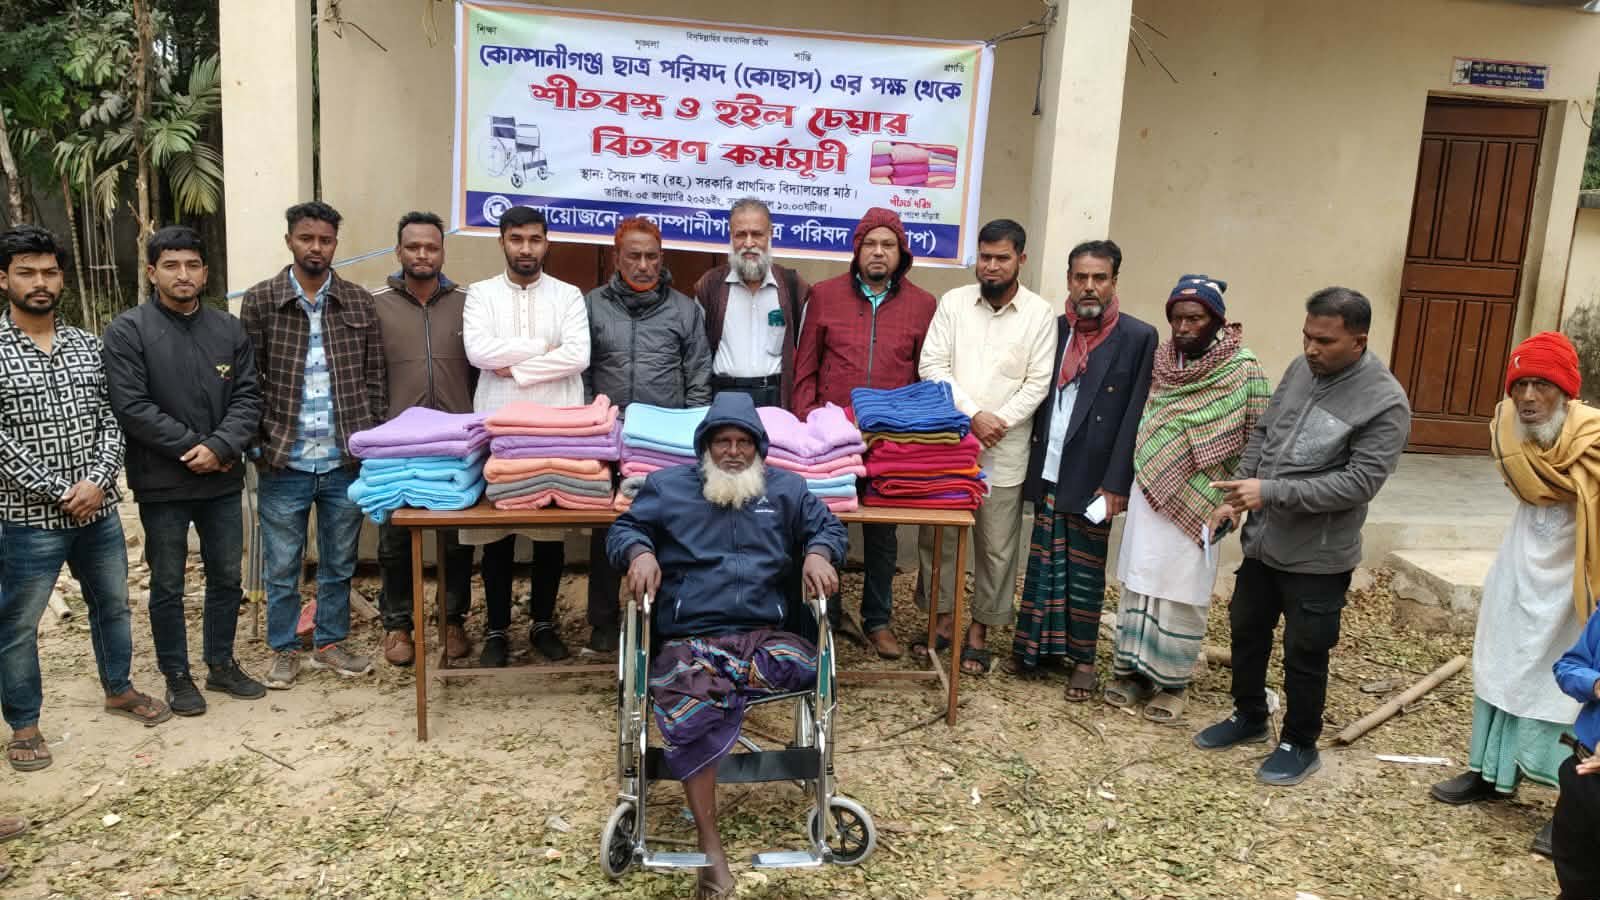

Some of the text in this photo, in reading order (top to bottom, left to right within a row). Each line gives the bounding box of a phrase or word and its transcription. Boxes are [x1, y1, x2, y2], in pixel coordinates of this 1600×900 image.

[479, 43, 962, 102] কোম্পানীগঞ্জ ছাত্র পরিষদ (কোছাপ) এর পক্ষ থেকে
[530, 74, 911, 138] শীতবস্ত্র ও হুইল চেয়ার
[592, 126, 849, 179] বিতরণ কর্মসূচী
[640, 173, 660, 185] শাহ
[695, 176, 733, 191] সরকারি
[736, 179, 776, 193] প্রাথমিক
[790, 219, 851, 246] পরিষদ
